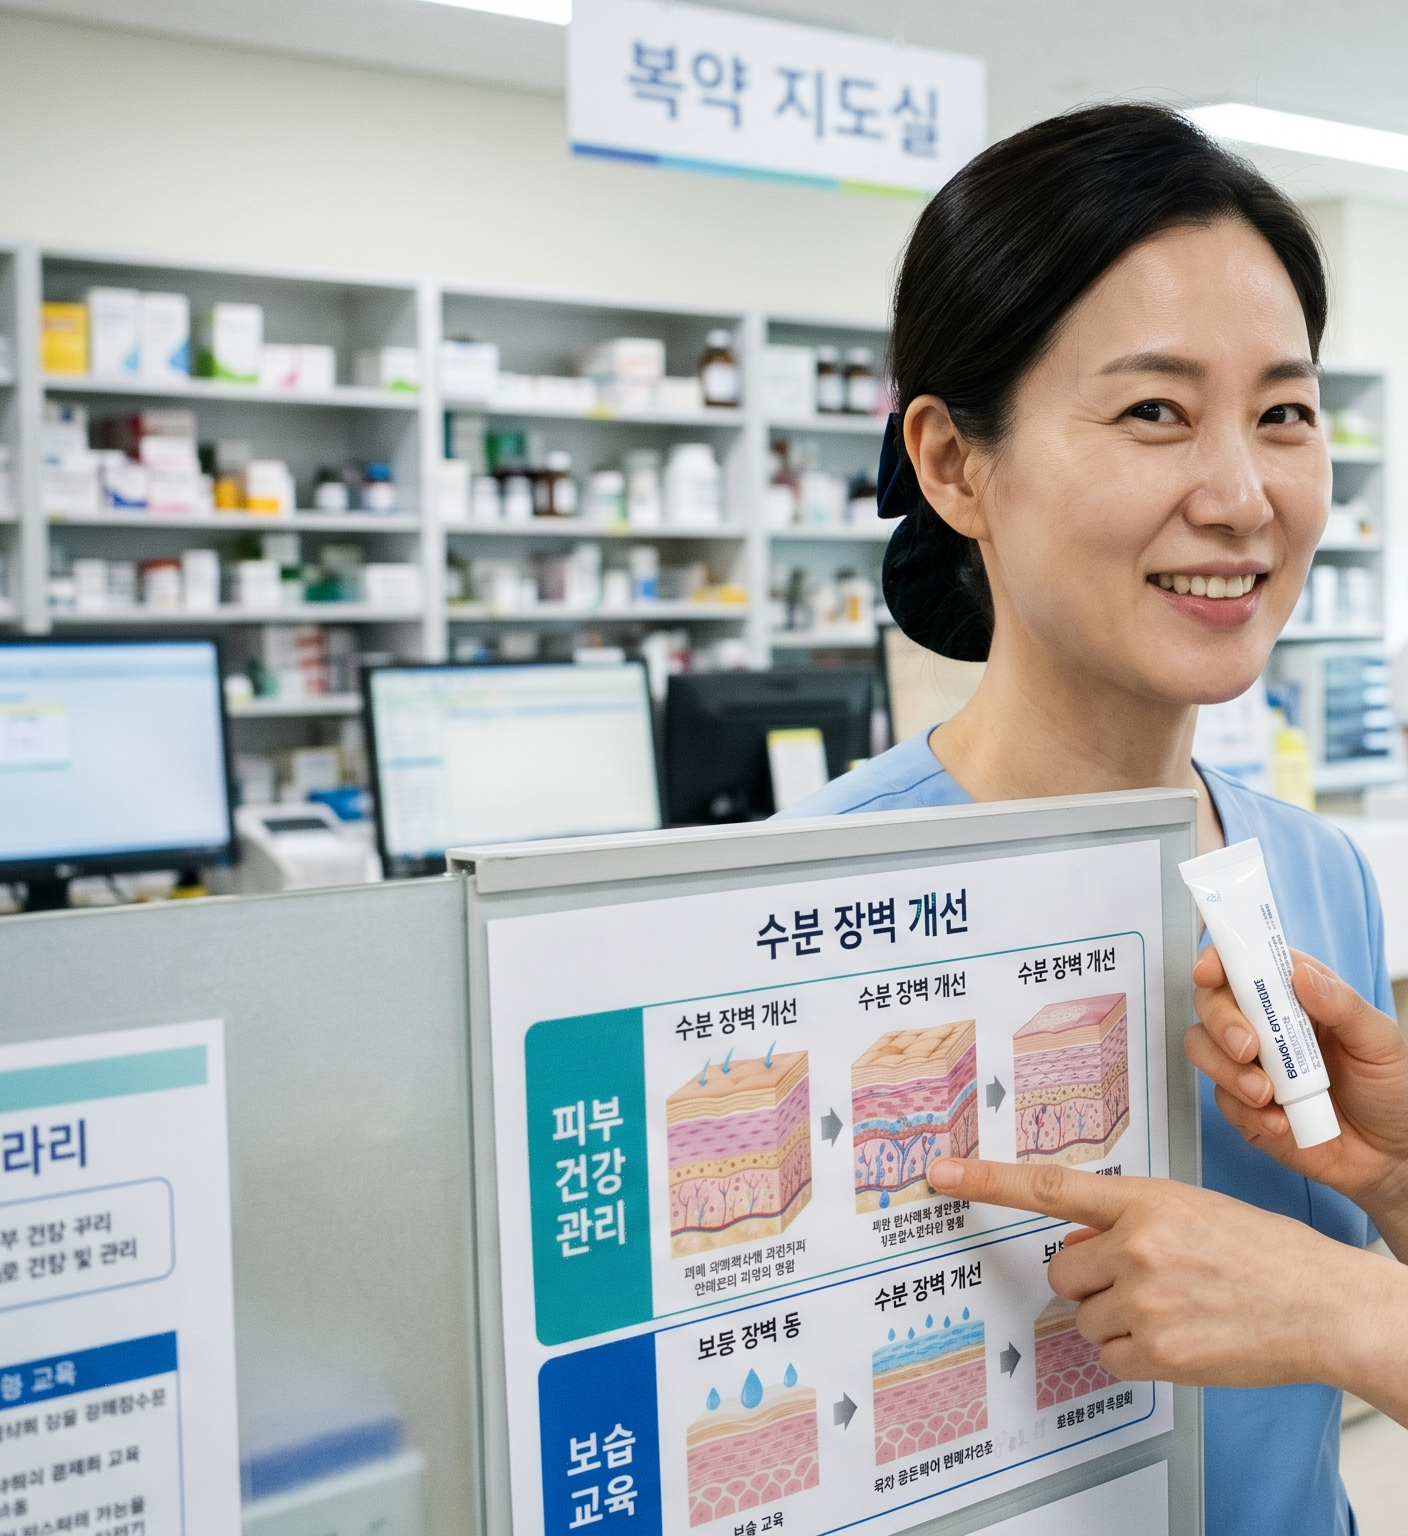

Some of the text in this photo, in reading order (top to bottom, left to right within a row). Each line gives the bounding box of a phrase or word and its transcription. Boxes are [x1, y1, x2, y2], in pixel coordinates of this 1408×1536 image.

[626, 38, 940, 161] 복약 지도실
[756, 888, 968, 960] 수분 장벽 개선
[858, 971, 967, 1011] 수분 장벽 개선
[1017, 947, 1116, 986] 수분 장벽 개선
[675, 997, 798, 1042] 수분 장벽 개선
[552, 1095, 624, 1146] 피부
[1, 1118, 88, 1176] 라리
[555, 1147, 627, 1203] 건강
[555, 1199, 627, 1258] 관리
[1043, 1241, 1065, 1264] 보
[874, 1261, 983, 1312] 수분 장벽 개선
[741, 1316, 778, 1349] 장벽
[782, 1311, 803, 1339] 동
[567, 1423, 636, 1477] 보습
[569, 1474, 638, 1529] 교육
[761, 1511, 784, 1531] 교육
